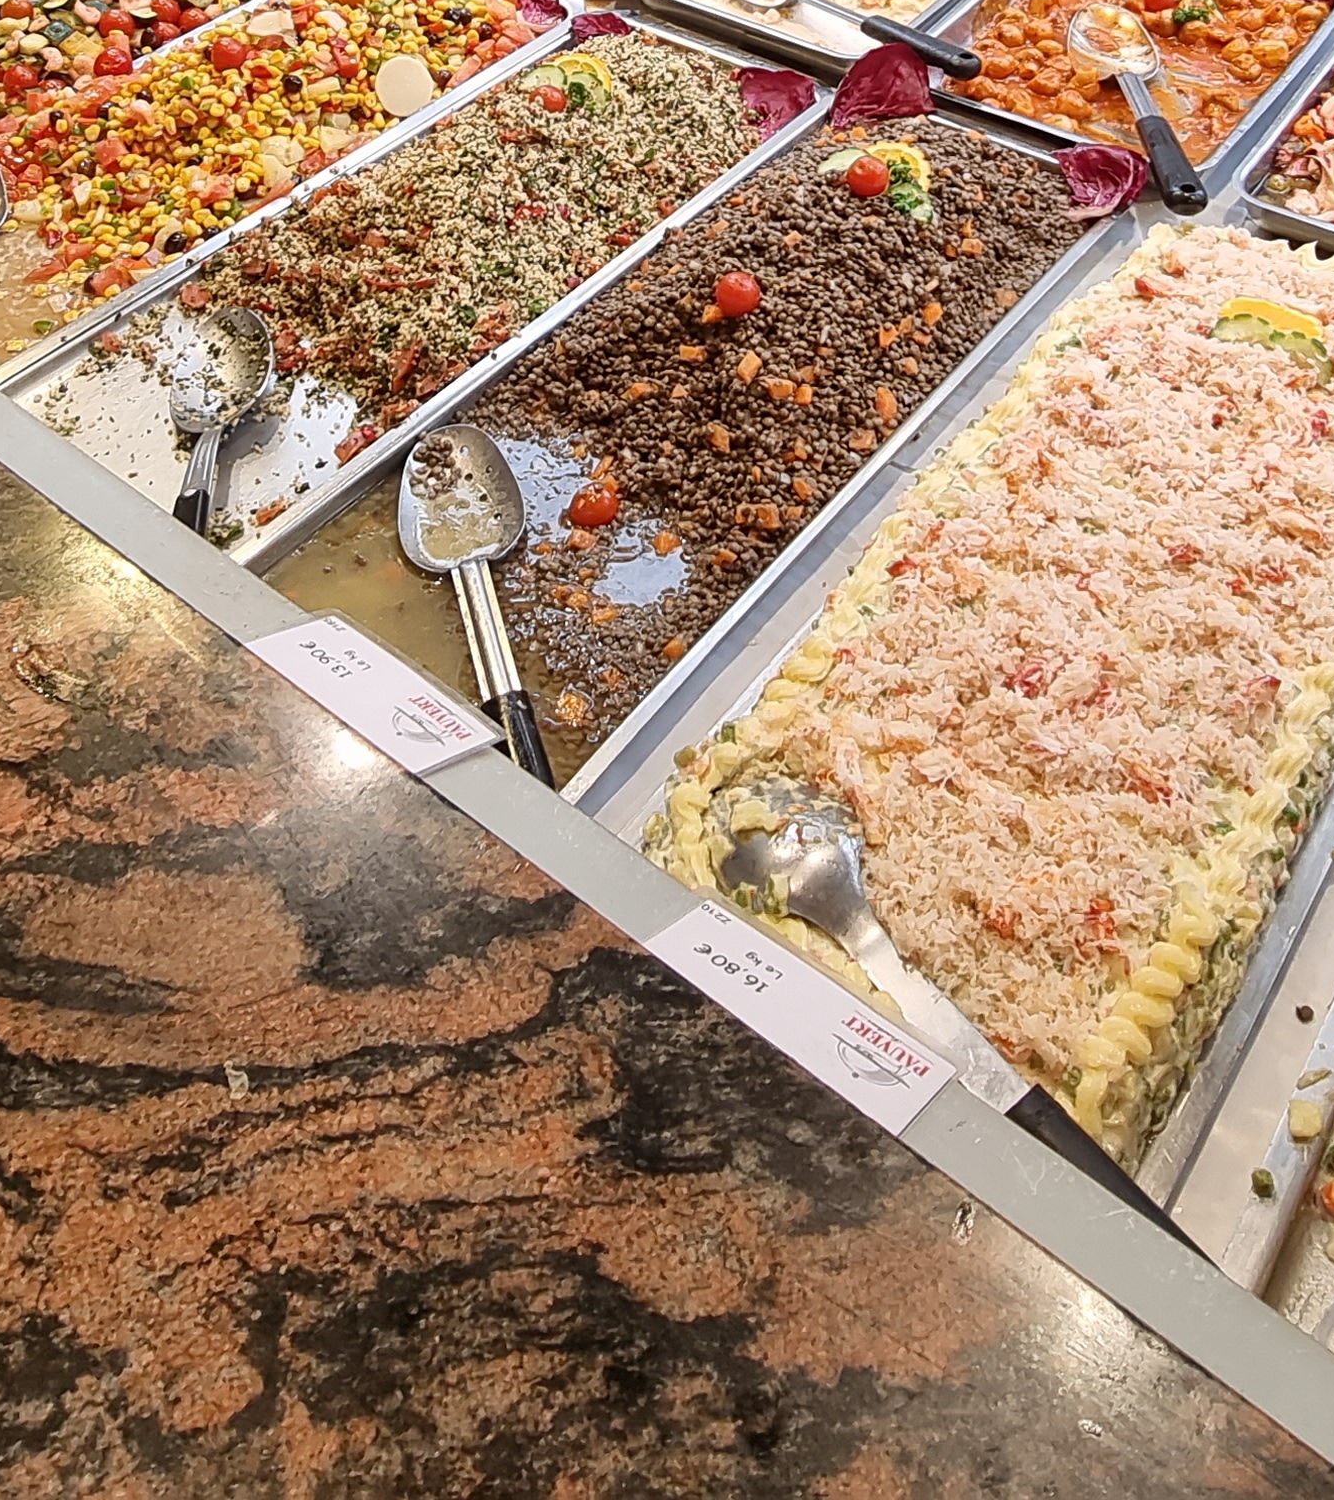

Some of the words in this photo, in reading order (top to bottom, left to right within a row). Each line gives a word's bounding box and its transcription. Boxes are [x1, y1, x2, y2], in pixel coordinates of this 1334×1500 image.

[299, 639, 353, 680] 13,90€
[344, 649, 357, 663] kg
[357, 657, 372, 672] Le
[408, 694, 473, 742] PAUVERT
[700, 902, 734, 925] Z210
[744, 951, 763, 967] kg
[765, 964, 784, 981] Le
[842, 1015, 931, 1079] PAUVERT
